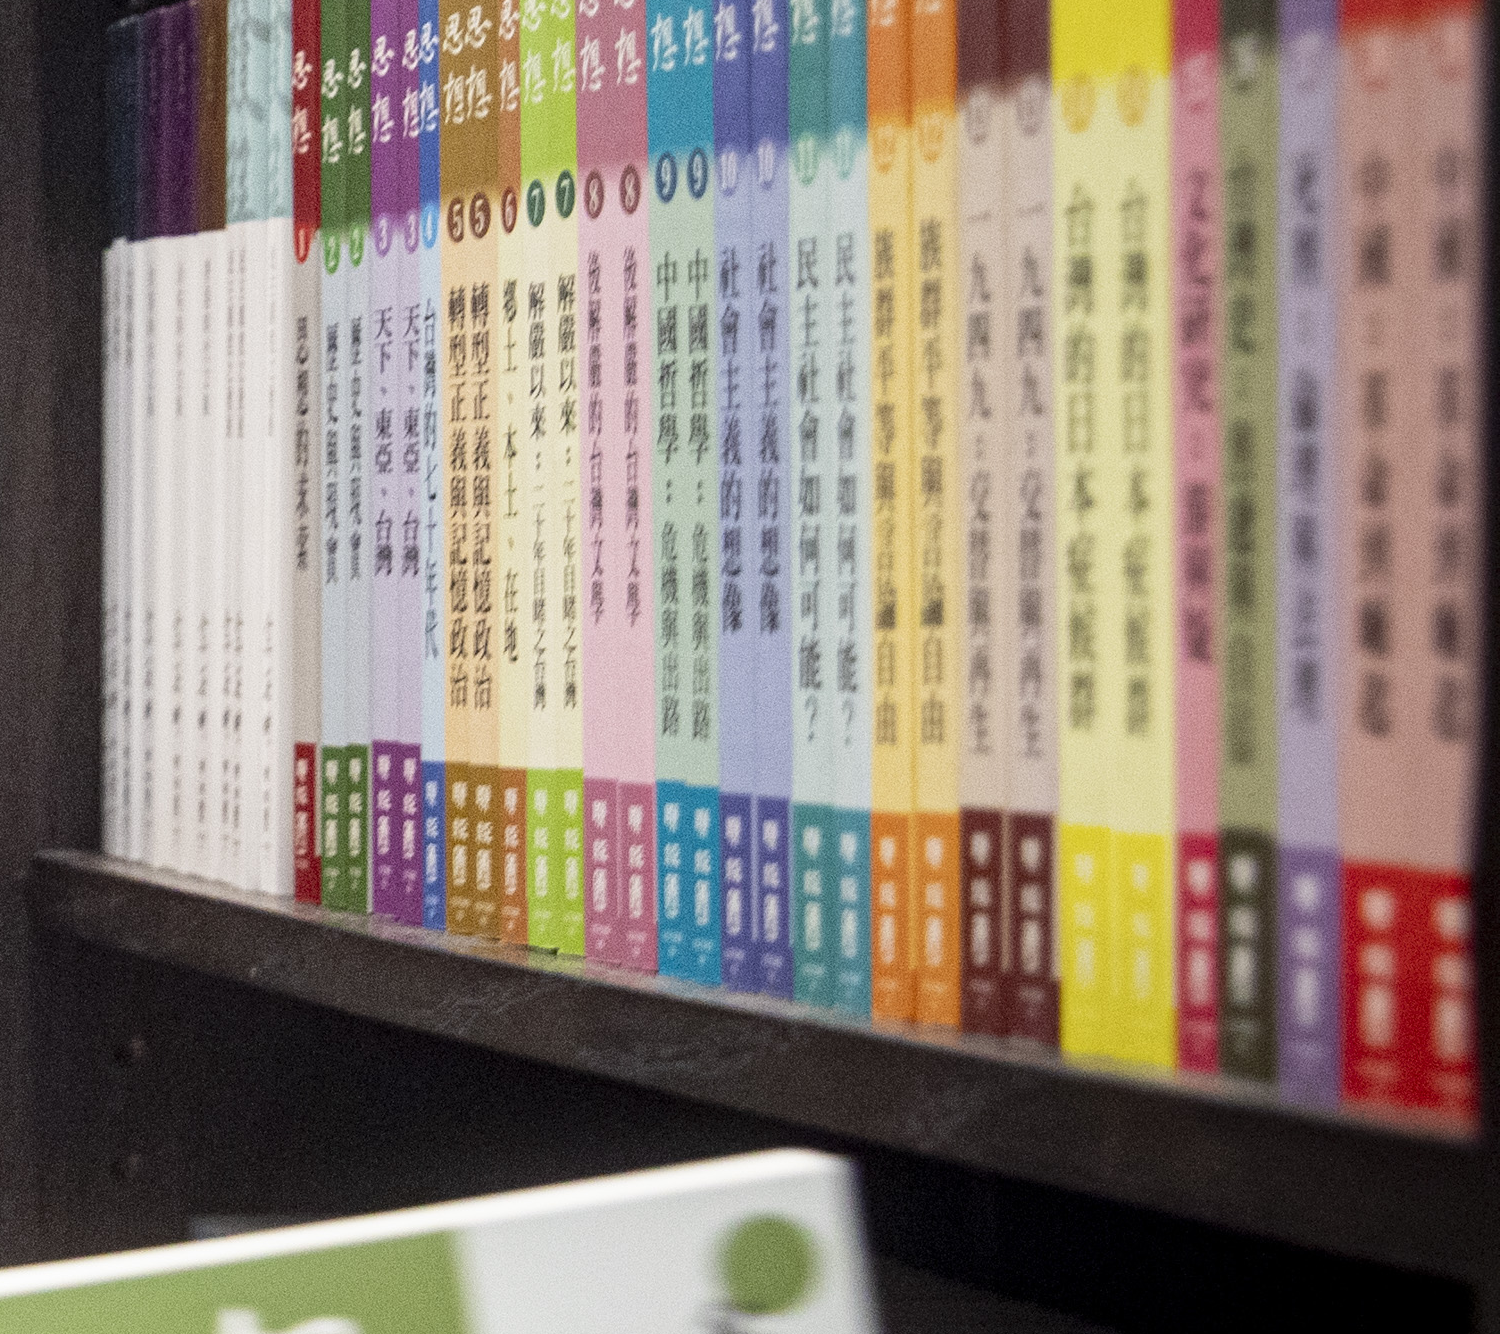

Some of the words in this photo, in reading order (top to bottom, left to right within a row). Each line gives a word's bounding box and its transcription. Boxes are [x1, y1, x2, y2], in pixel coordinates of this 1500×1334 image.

[291, 51, 312, 154] 思想
[321, 58, 343, 165] 思想
[347, 48, 366, 155] 思想
[371, 35, 394, 144] 思想
[401, 28, 421, 138] 思想
[418, 21, 438, 133] 思想
[442, 13, 467, 125] 思想
[466, 5, 491, 119] 思想
[720, 245, 743, 635] 社會主義的想像
[756, 239, 781, 635] 社會主義的想像
[449, 284, 468, 711] 轉型正義與記憶政治
[471, 280, 491, 712] 轉型正義與記憶政治
